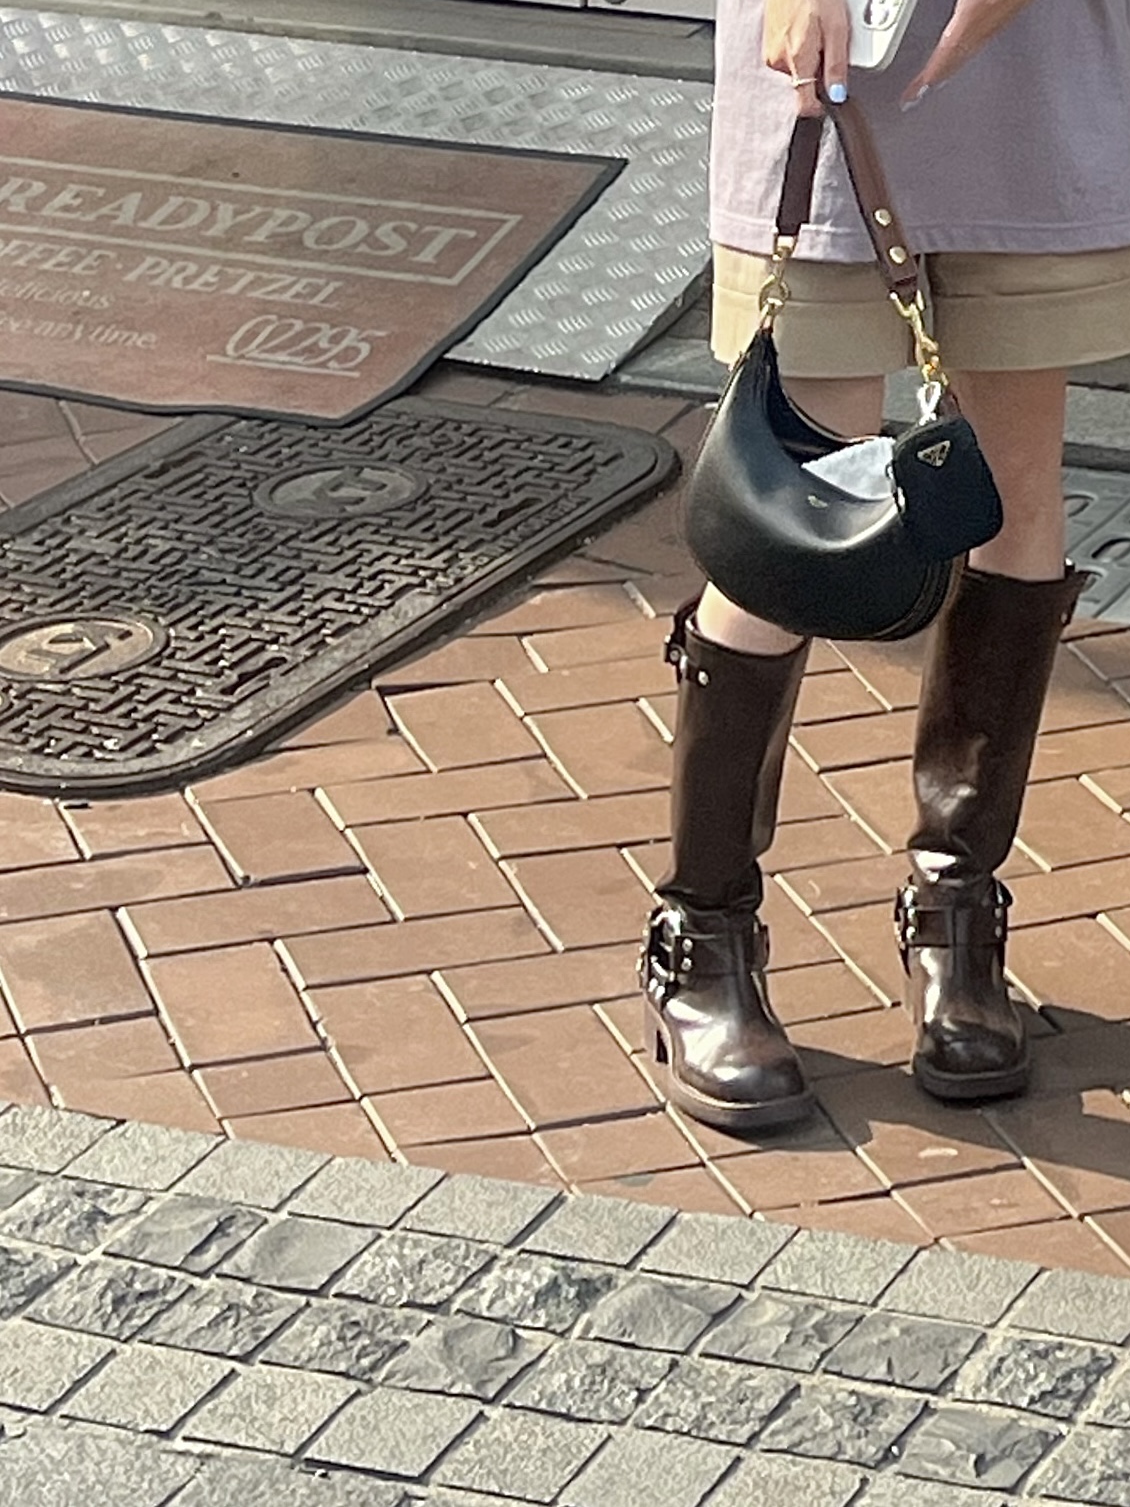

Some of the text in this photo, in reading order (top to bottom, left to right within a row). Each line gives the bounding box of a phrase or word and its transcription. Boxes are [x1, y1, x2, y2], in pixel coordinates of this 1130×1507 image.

[0, 238, 344, 309] FFEE PRETZEL
[225, 314, 390, 370] 02295
